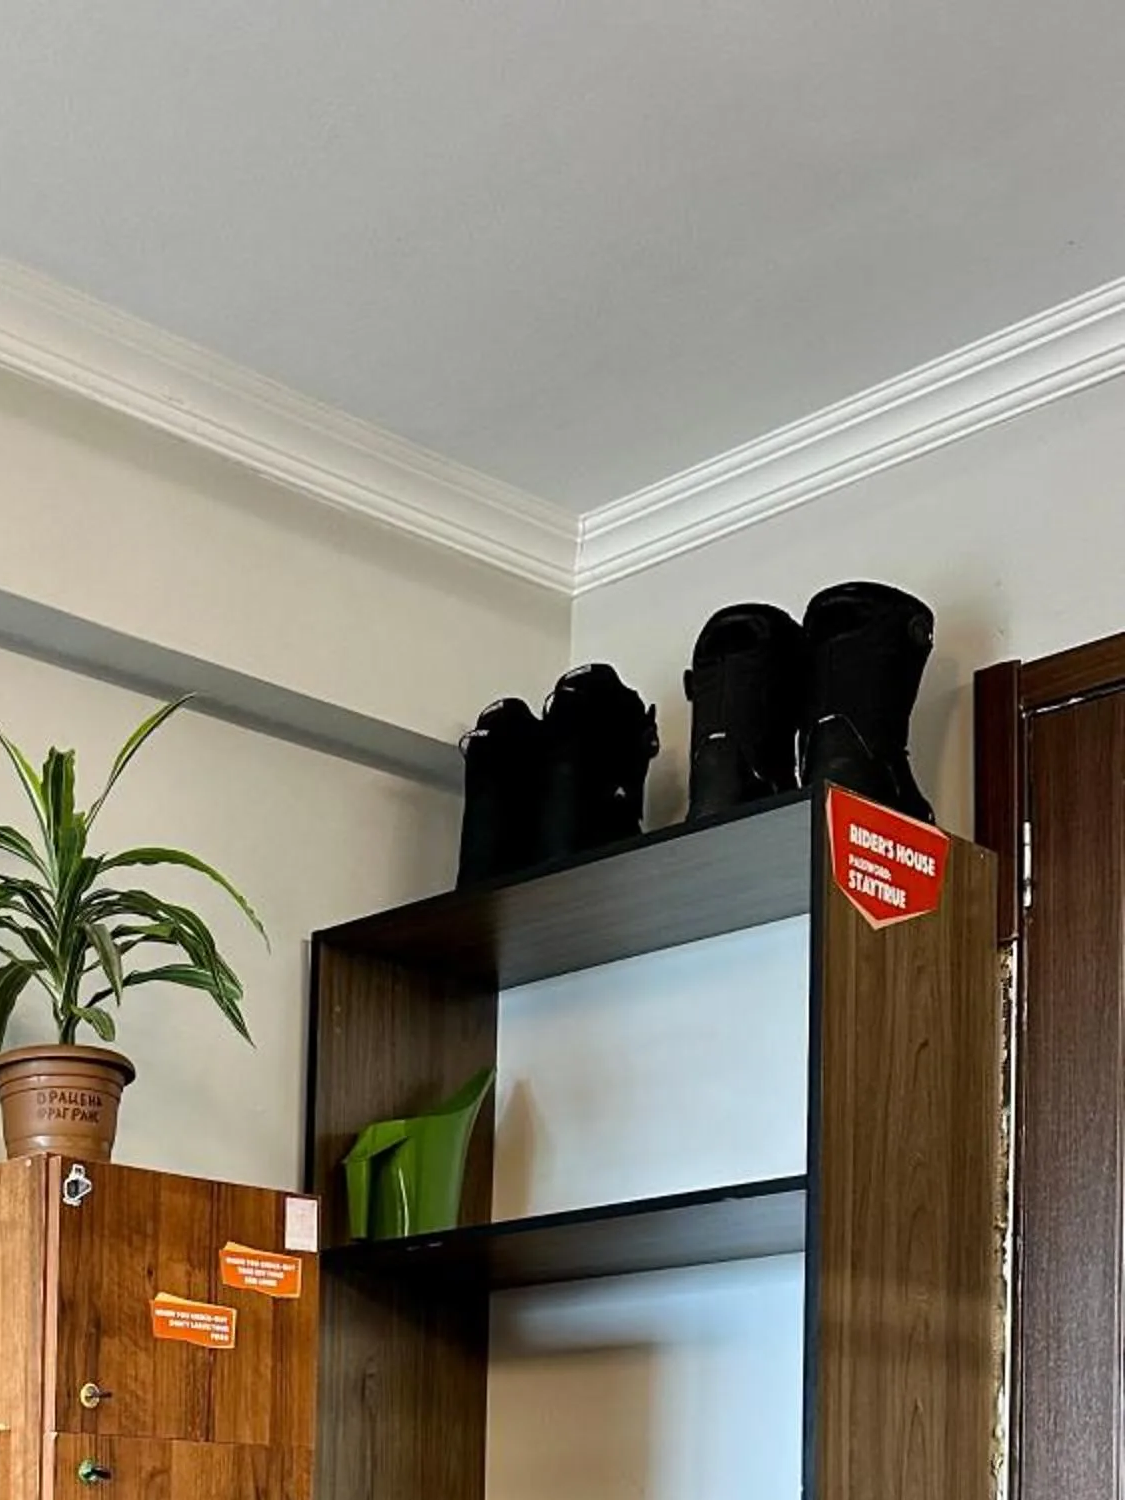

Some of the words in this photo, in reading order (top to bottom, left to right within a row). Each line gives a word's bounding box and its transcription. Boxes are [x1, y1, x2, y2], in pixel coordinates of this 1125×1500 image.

[848, 823, 894, 860] RIDER'S
[895, 843, 936, 877] HOUSE
[848, 868, 907, 909] STAYTRUE
